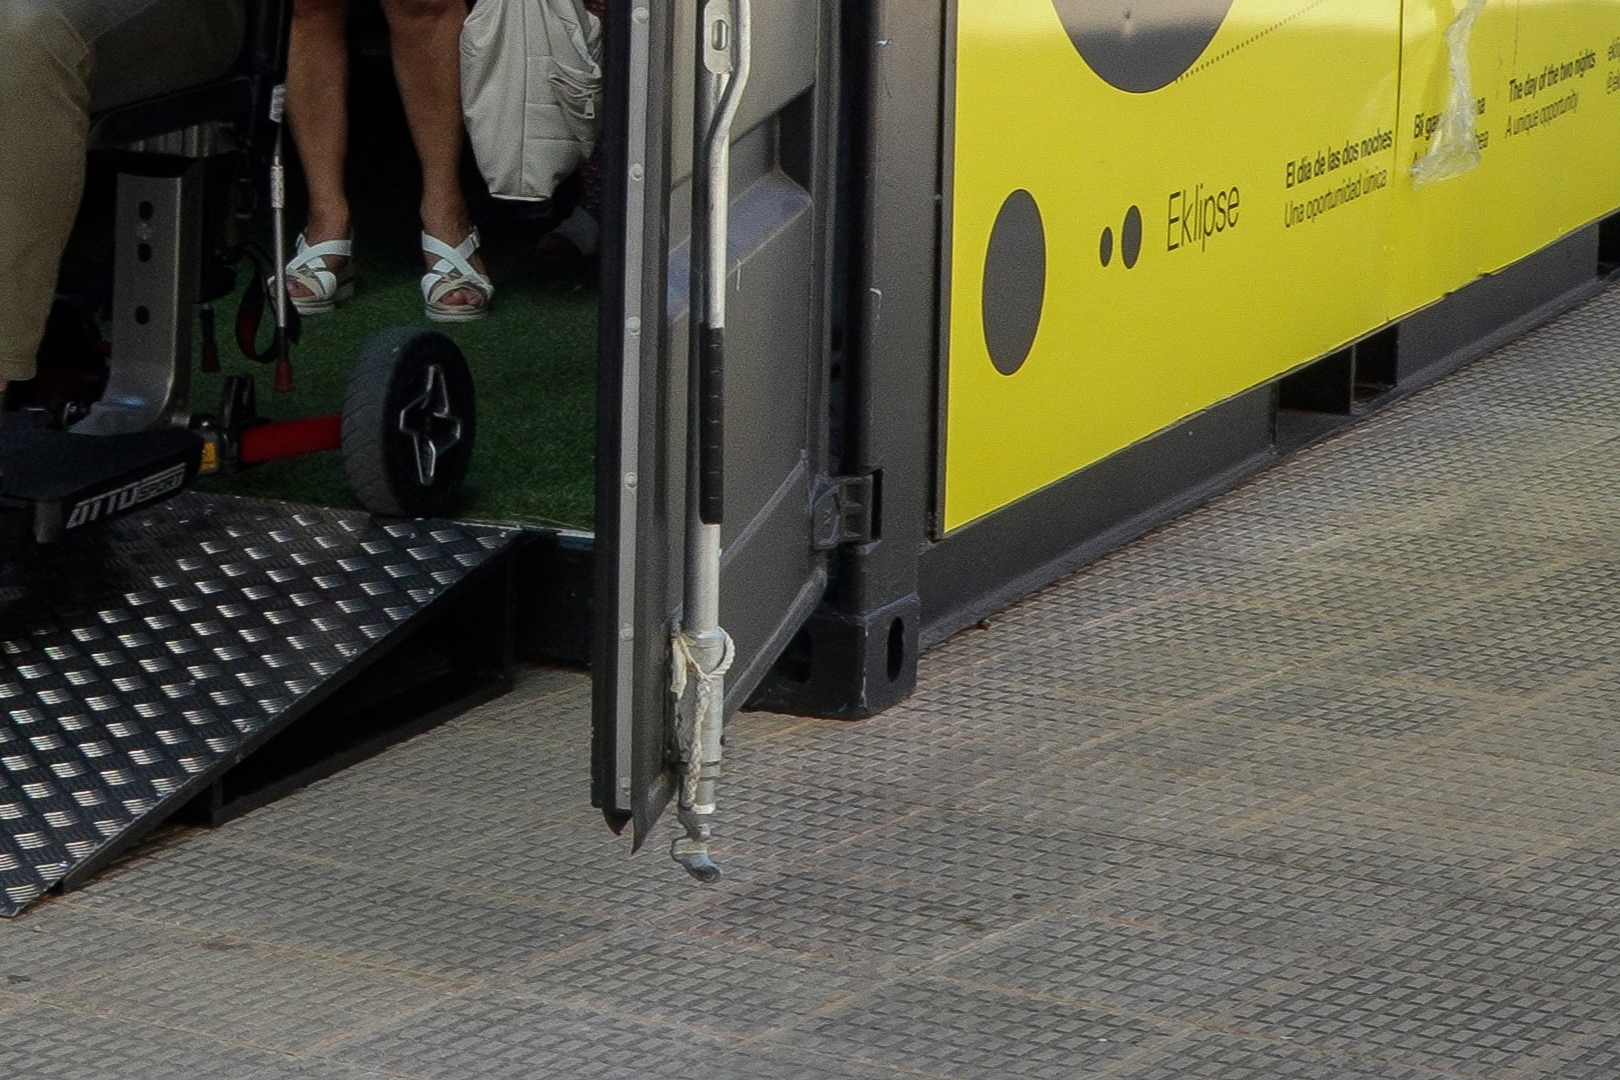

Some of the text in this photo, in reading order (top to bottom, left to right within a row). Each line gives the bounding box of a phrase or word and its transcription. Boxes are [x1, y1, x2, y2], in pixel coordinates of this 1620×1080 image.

[1508, 78, 1523, 103] The
[1504, 115, 1512, 139] A
[1285, 160, 1296, 189] El
[1314, 150, 1326, 177] de
[1327, 145, 1341, 172] las
[1342, 139, 1359, 166] dos
[1360, 127, 1393, 160] noches
[1167, 182, 1240, 253] Eklipse
[1284, 200, 1305, 228] Una
[1306, 172, 1362, 223] oportunidad
